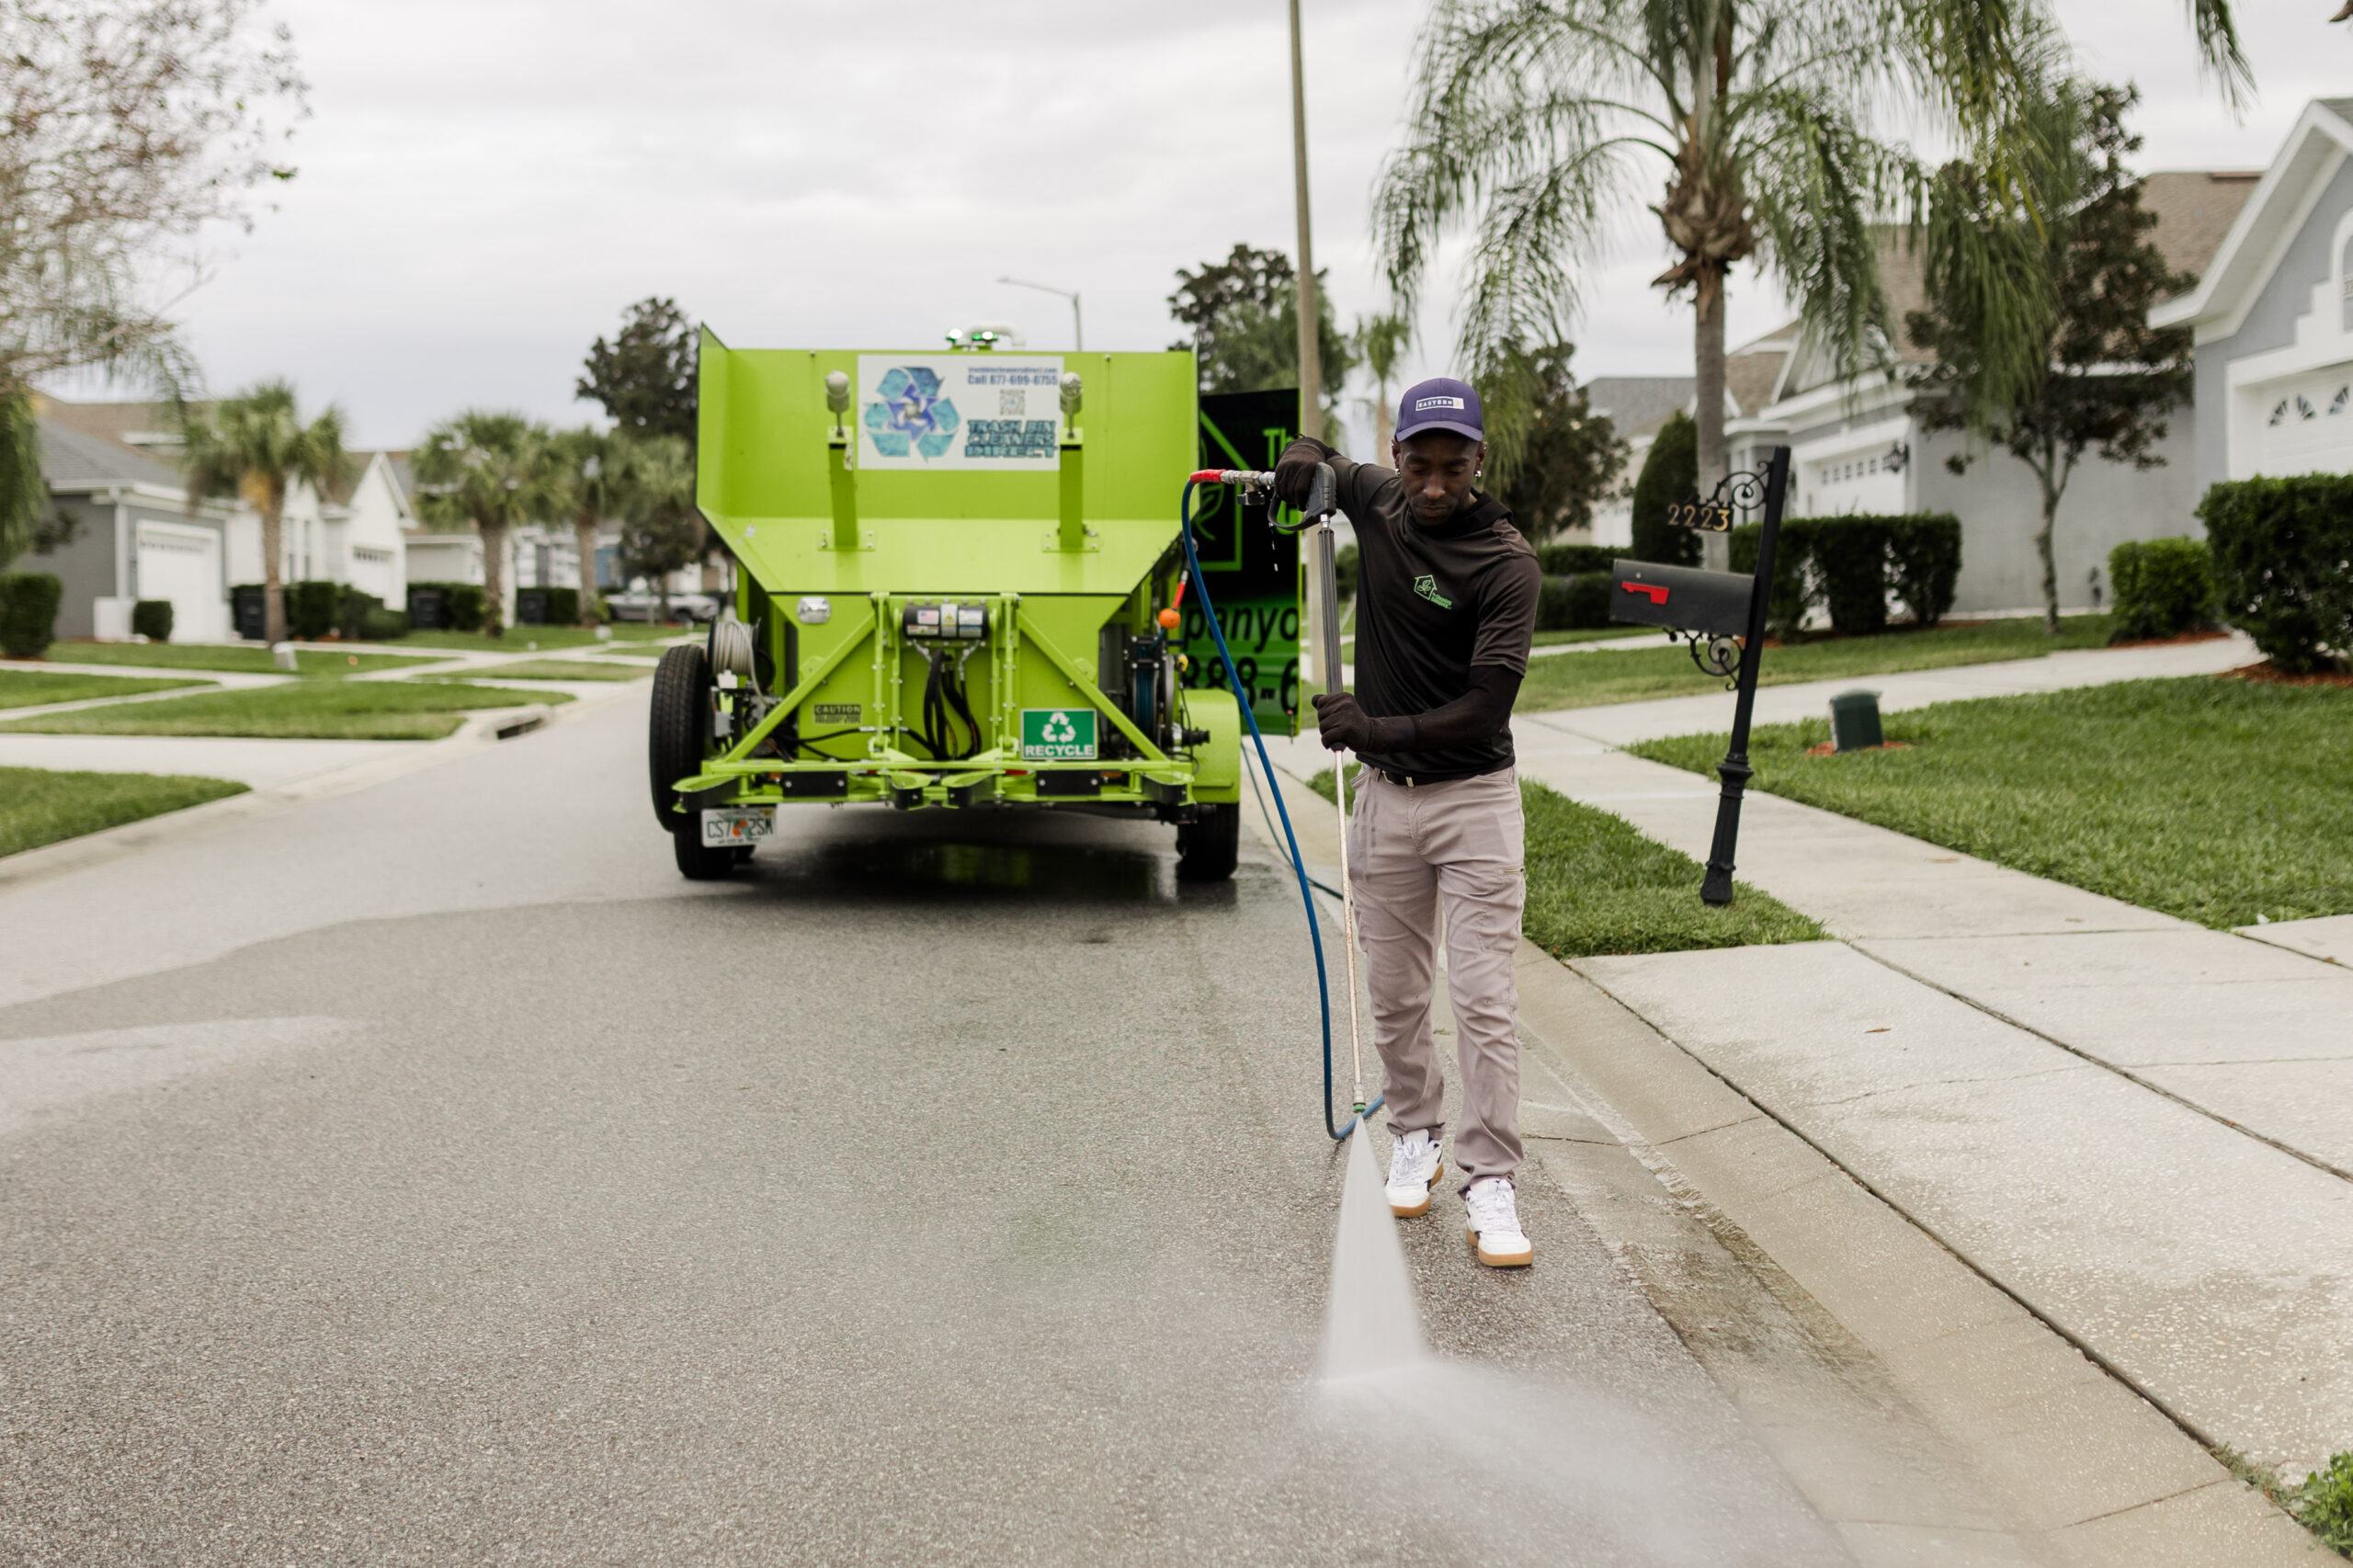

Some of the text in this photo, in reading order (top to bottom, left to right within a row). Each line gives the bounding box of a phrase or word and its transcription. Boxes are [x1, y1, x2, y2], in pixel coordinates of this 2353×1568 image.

[968, 375, 987, 384] Call
[968, 420, 1056, 434] TRASH BIN
[968, 433, 1055, 446] CLEANERS
[1667, 504, 1730, 531] 2223
[815, 705, 861, 714] CAUTION
[1025, 744, 1095, 756] RECYCLE
